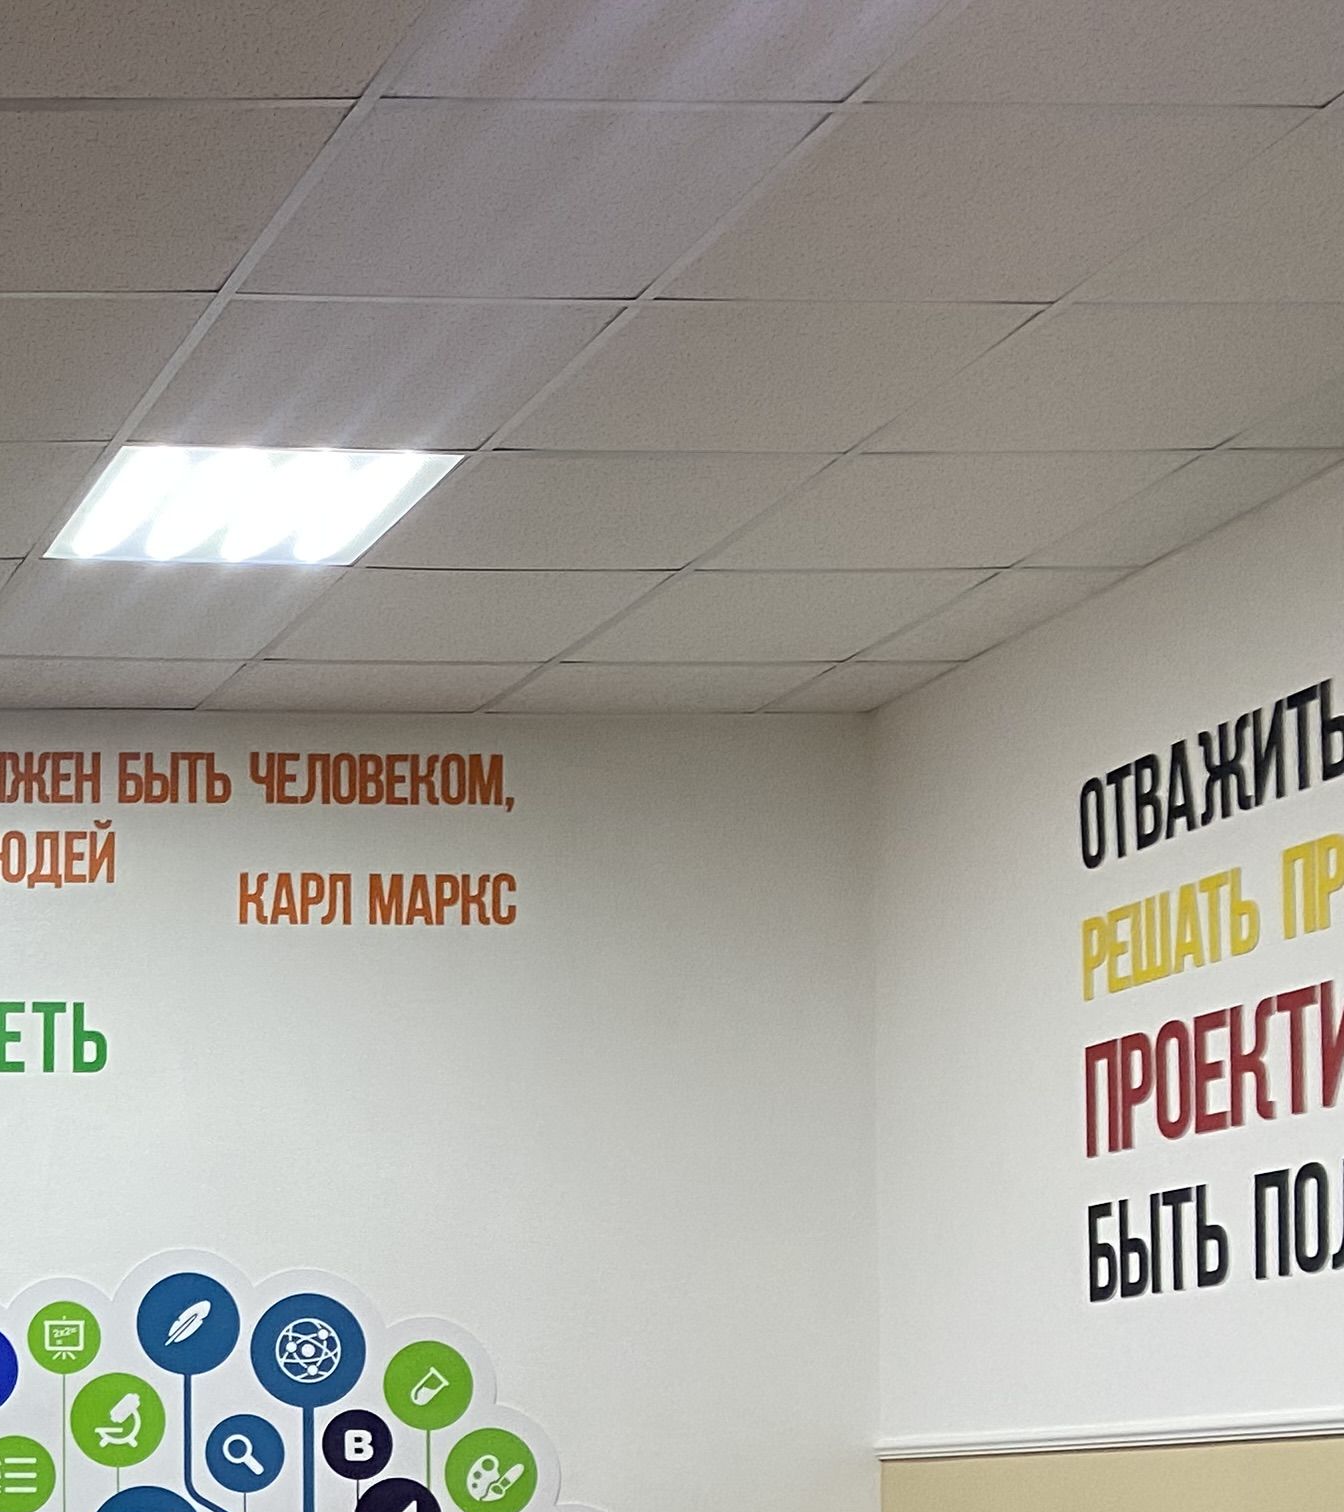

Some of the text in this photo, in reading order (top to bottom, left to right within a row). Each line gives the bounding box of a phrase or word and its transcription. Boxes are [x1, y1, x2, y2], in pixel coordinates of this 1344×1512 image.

[118, 752, 232, 807] БЫТЬ
[248, 753, 514, 811] ЧЕЛОВЕКОМ,
[237, 871, 518, 928] КАРЛ МАРКС
[1082, 867, 1260, 1002] РЕШАТЬ
[1088, 1184, 1230, 1303] БЫТЬ
[343, 1428, 375, 1462] B
